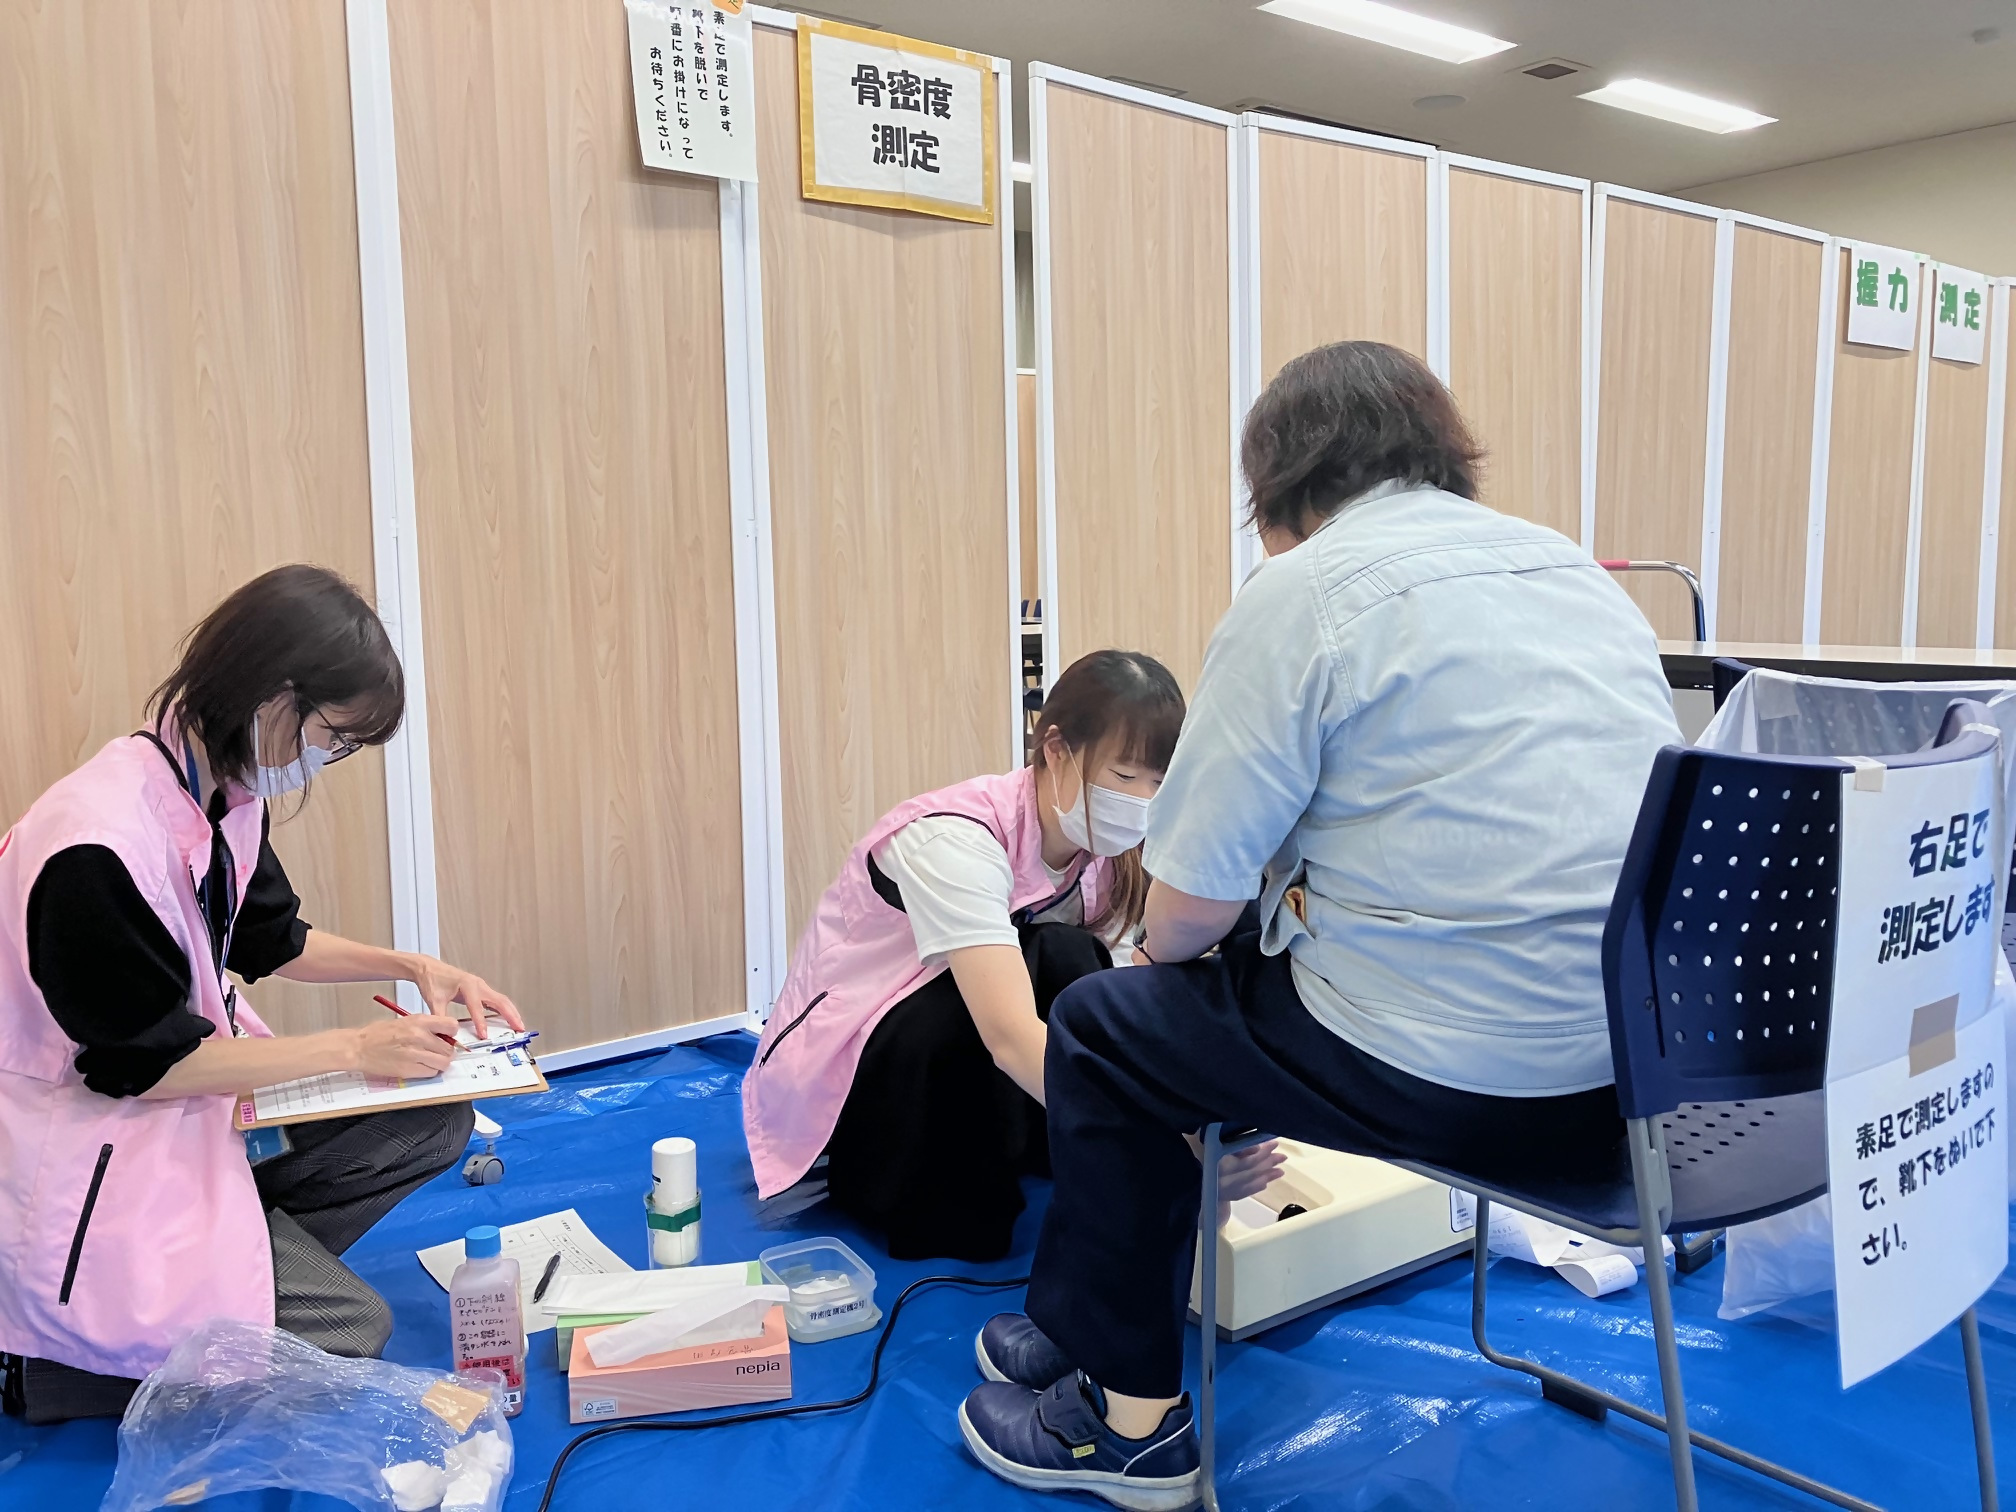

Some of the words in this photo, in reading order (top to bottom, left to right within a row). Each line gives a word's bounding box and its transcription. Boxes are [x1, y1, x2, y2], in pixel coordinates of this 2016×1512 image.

[649, 47, 673, 158] お待ちください。
[851, 64, 953, 120] 骨密度
[871, 123, 940, 174] 測定
[1856, 258, 1909, 313] 握力
[1939, 281, 1981, 331] 測定
[1908, 808, 1991, 878] 右足で
[1877, 873, 1996, 965] 測定します
[1855, 1062, 1995, 1160] 素足で測定しますの
[1858, 1107, 1996, 1211] で、靴下をぬいで下
[1861, 1222, 1908, 1266] さい。
[735, 1360, 781, 1376] nepia
